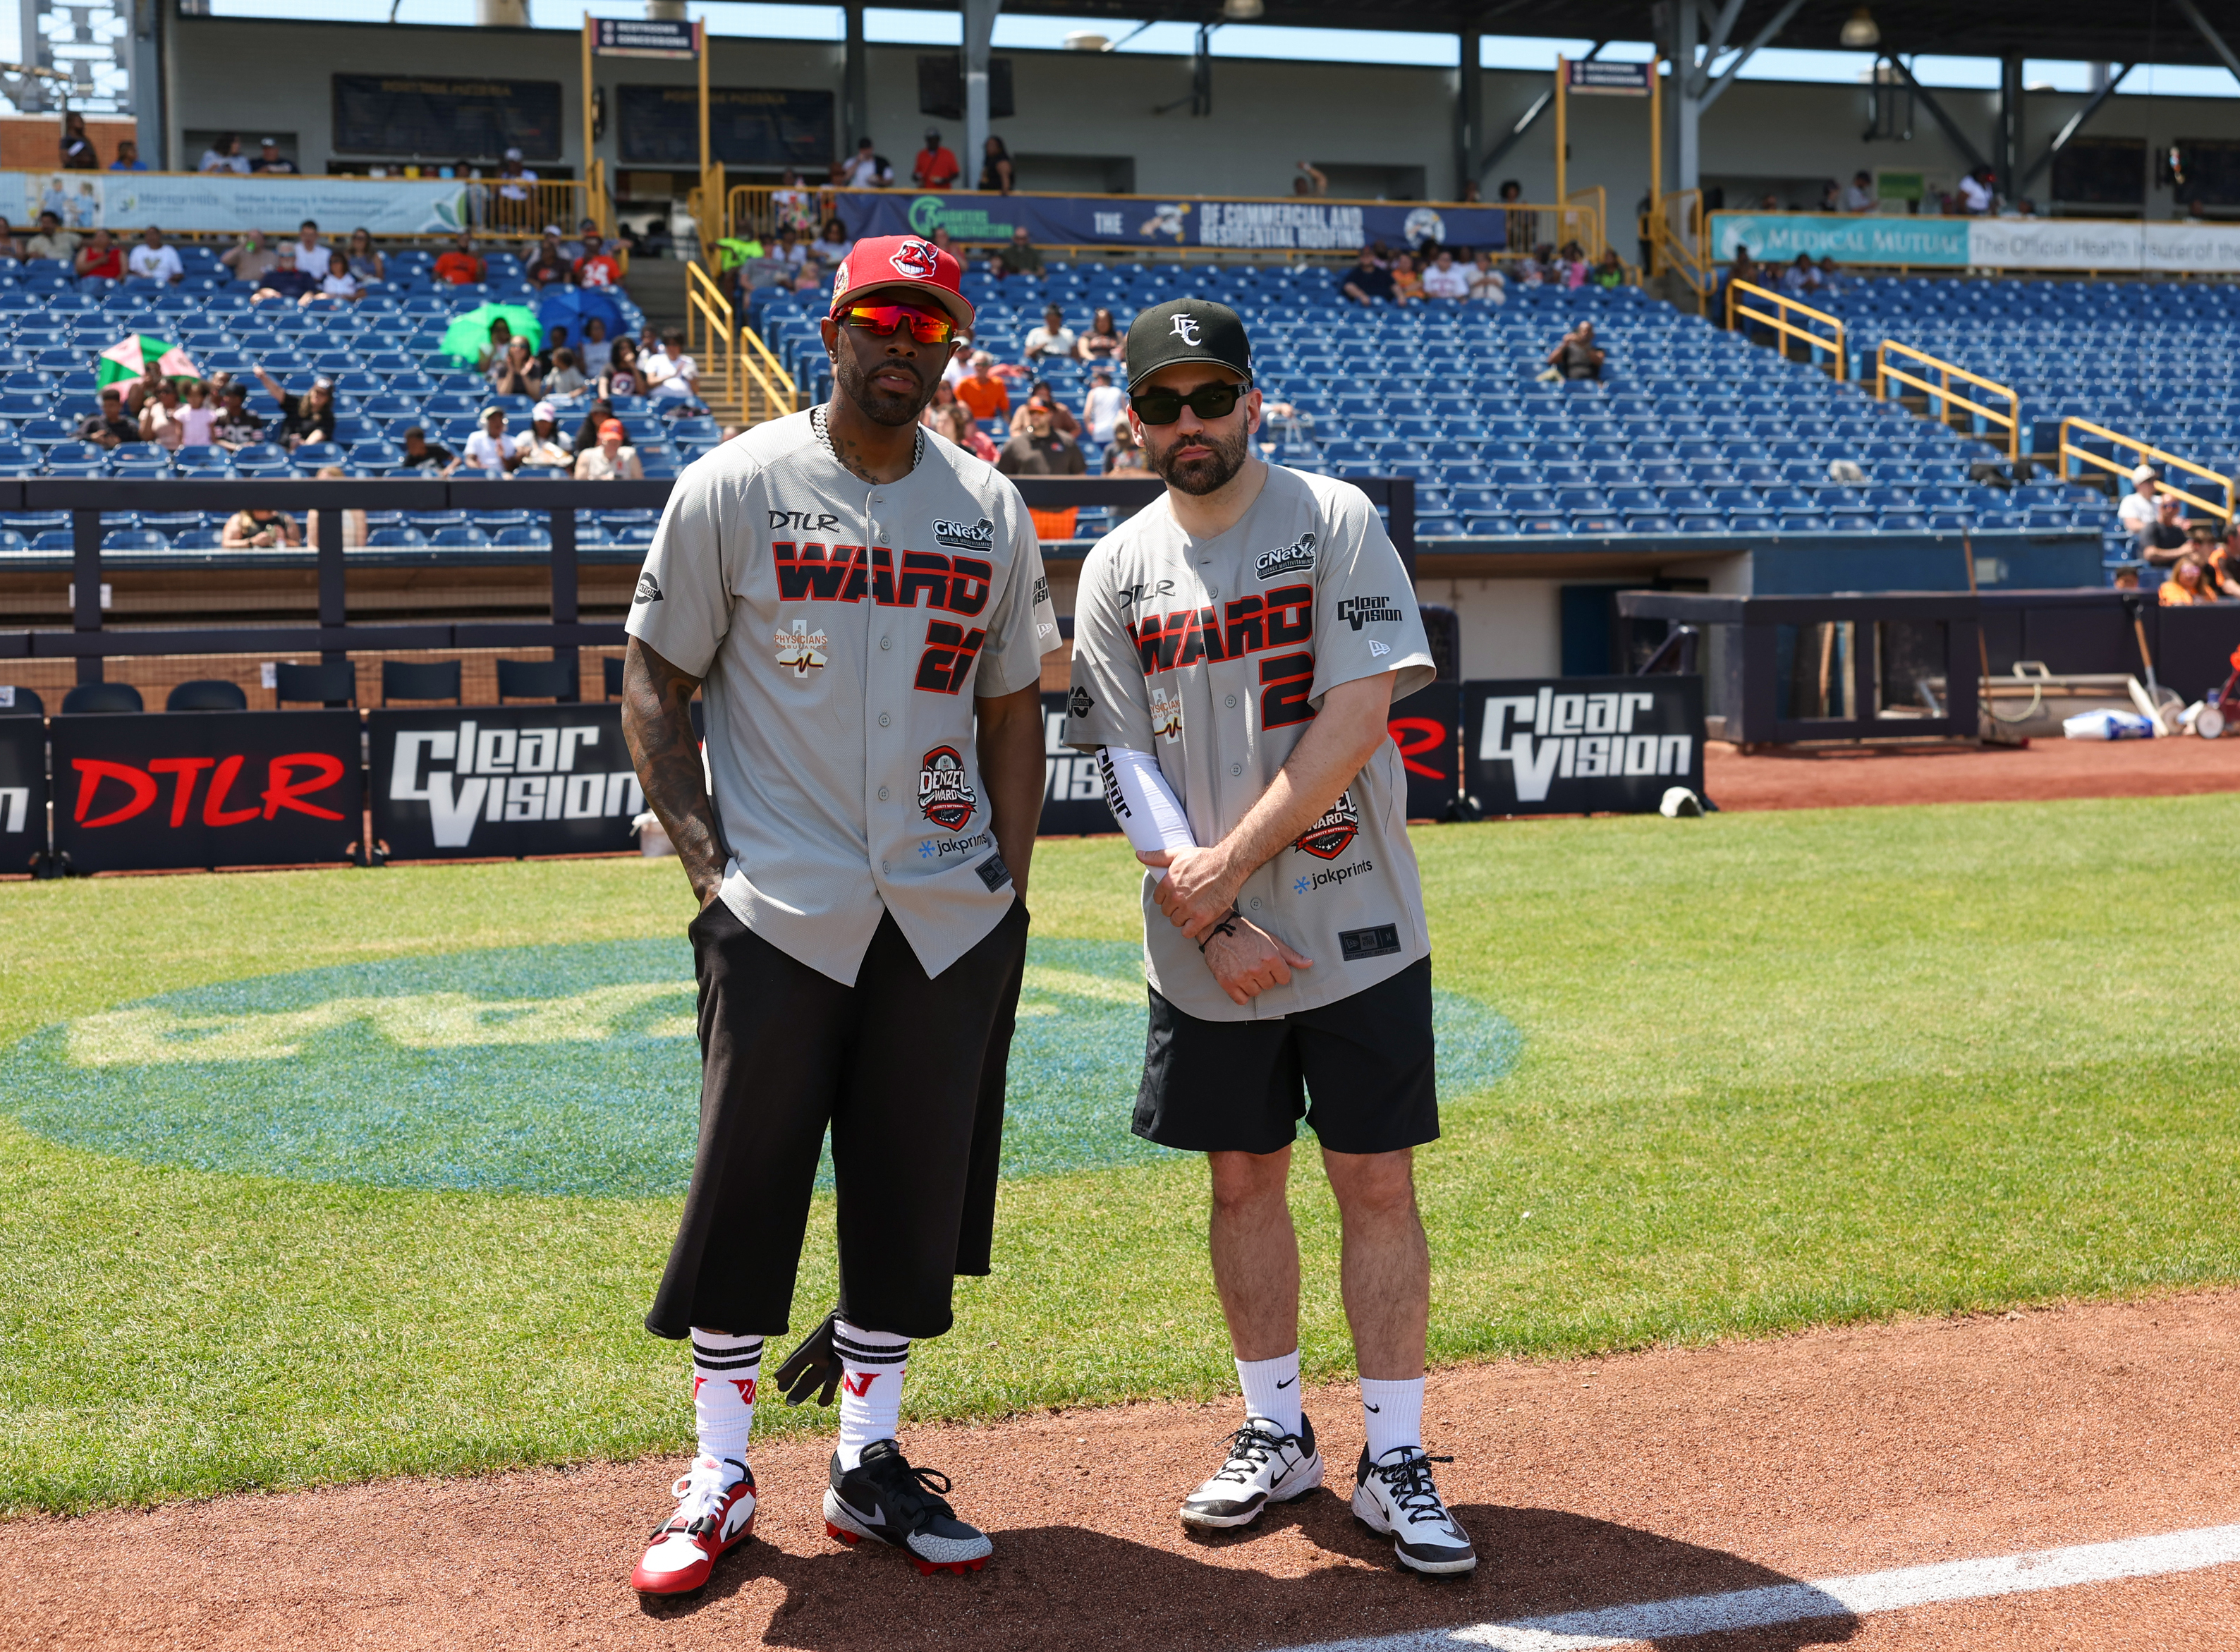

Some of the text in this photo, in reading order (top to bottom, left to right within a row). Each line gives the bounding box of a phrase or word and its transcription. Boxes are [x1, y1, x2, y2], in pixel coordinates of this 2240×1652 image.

[1094, 212, 1123, 235] THE
[1224, 203, 1326, 226] COMMERCIAL
[1329, 206, 1363, 227] AND
[1199, 225, 1365, 249] RESIDENTIAL ROOFING
[1767, 228, 1961, 255] MEDICAL MUTUAL
[769, 511, 839, 532] DTLR
[934, 521, 992, 541] GNetX
[960, 538, 992, 547] MULTIVITAMINS
[1256, 542, 1312, 569] GNetX
[1257, 559, 1313, 576] SEQUENCE MULTIVITAMINS
[772, 541, 993, 617] WARD
[1338, 596, 1389, 621] Clear
[1348, 609, 1402, 631] Vision
[774, 635, 827, 644] PHYSICIANS
[1125, 583, 1314, 676] WARD
[914, 619, 987, 696] 21
[1479, 687, 1653, 760] Clear
[389, 720, 599, 801] Clear
[1511, 732, 1693, 802] Vision
[71, 752, 346, 828] DTLR
[919, 770, 973, 795] DENZEL
[935, 789, 958, 801] WARD
[428, 771, 644, 848] Vision
[1306, 831, 1327, 840] CELEBRITY
[1312, 860, 1372, 890] jakprints
